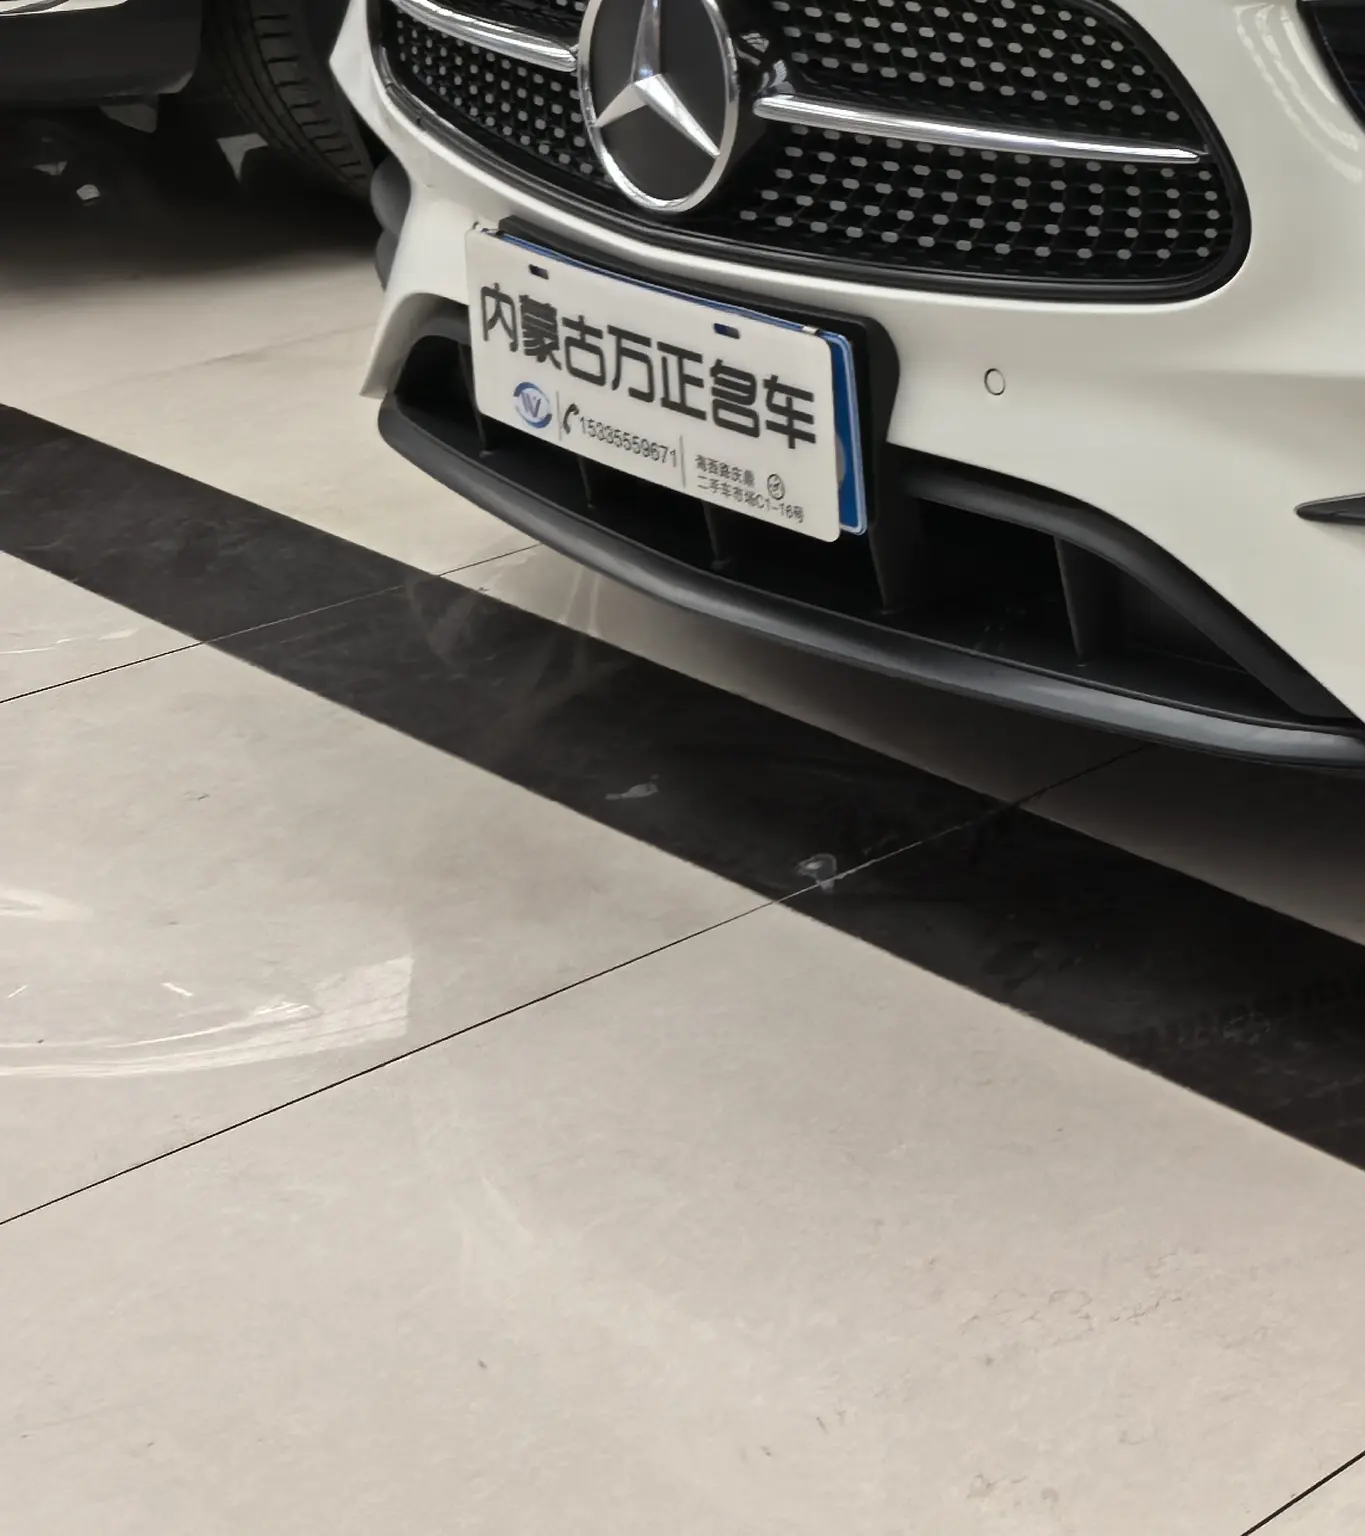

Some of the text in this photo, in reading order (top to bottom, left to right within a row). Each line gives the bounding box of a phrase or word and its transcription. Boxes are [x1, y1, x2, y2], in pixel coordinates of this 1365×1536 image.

[480, 282, 819, 451] 内蒙古万正名车
